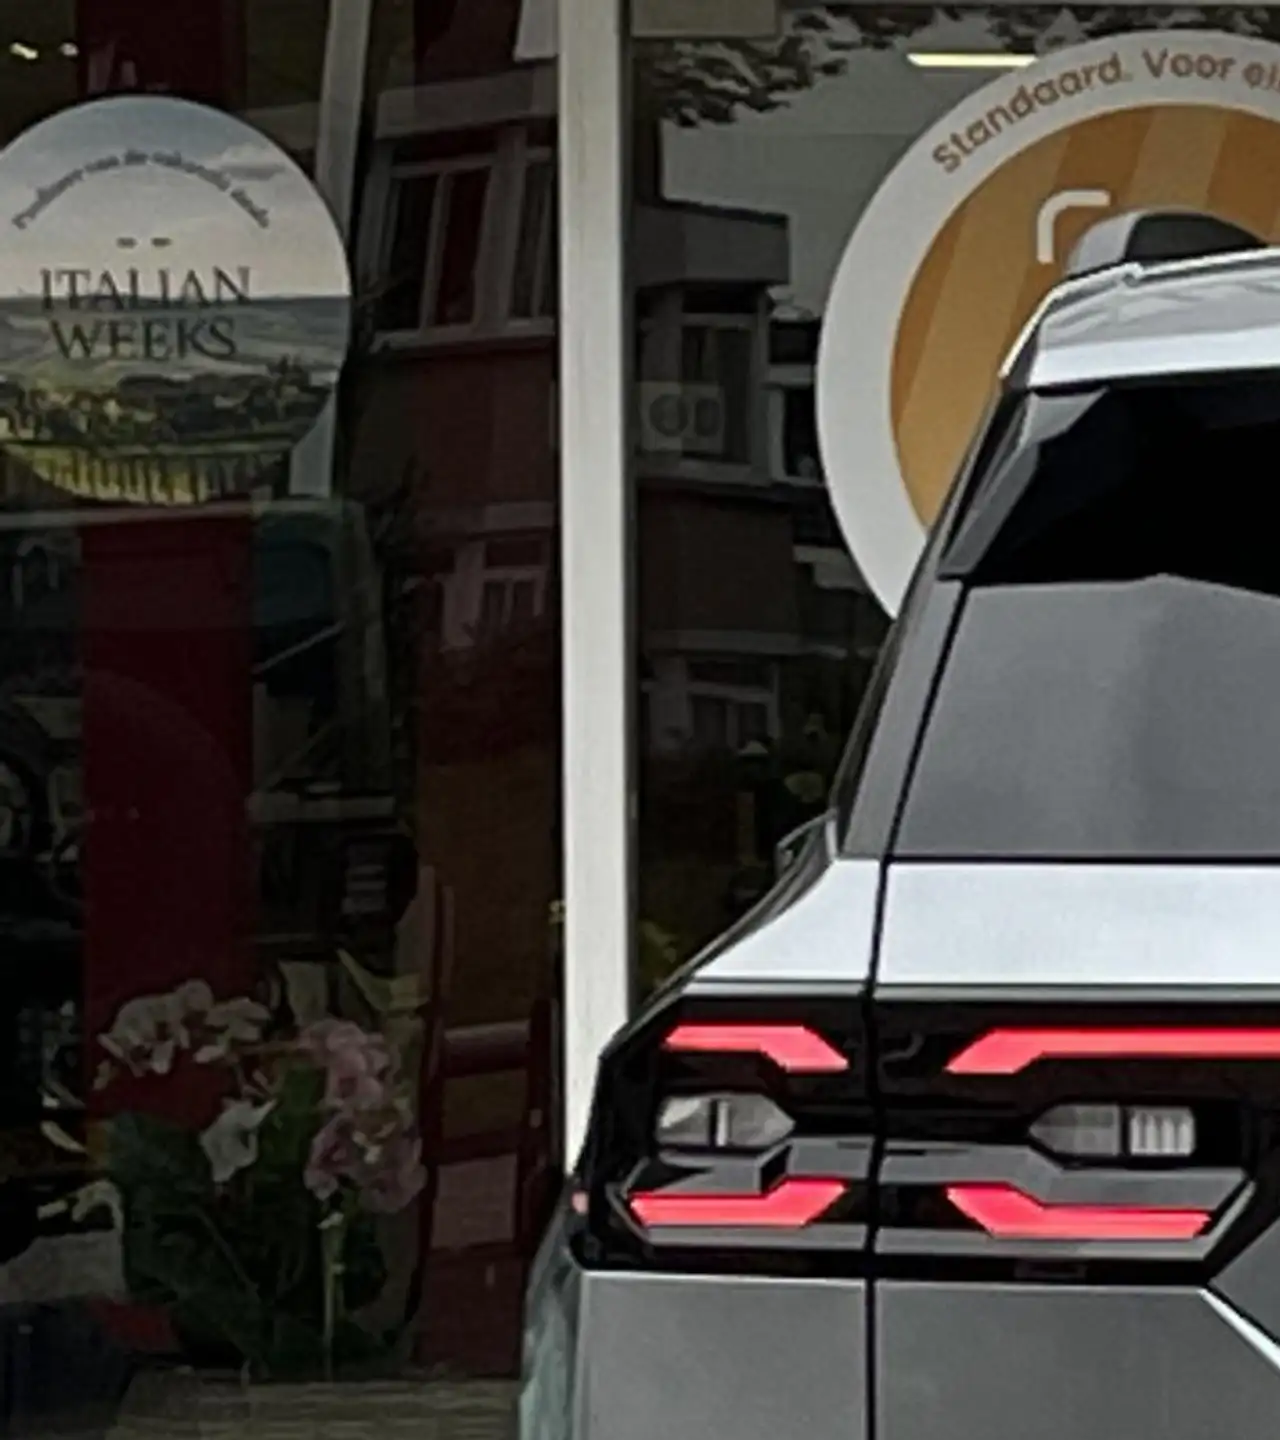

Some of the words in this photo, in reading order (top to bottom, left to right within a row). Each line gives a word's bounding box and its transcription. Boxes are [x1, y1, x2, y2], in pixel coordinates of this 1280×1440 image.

[932, 52, 1133, 174] Standaard.
[1142, 48, 1237, 79] Voor
[40, 265, 253, 310] ITALIAN
[50, 316, 237, 361] WEEKS
